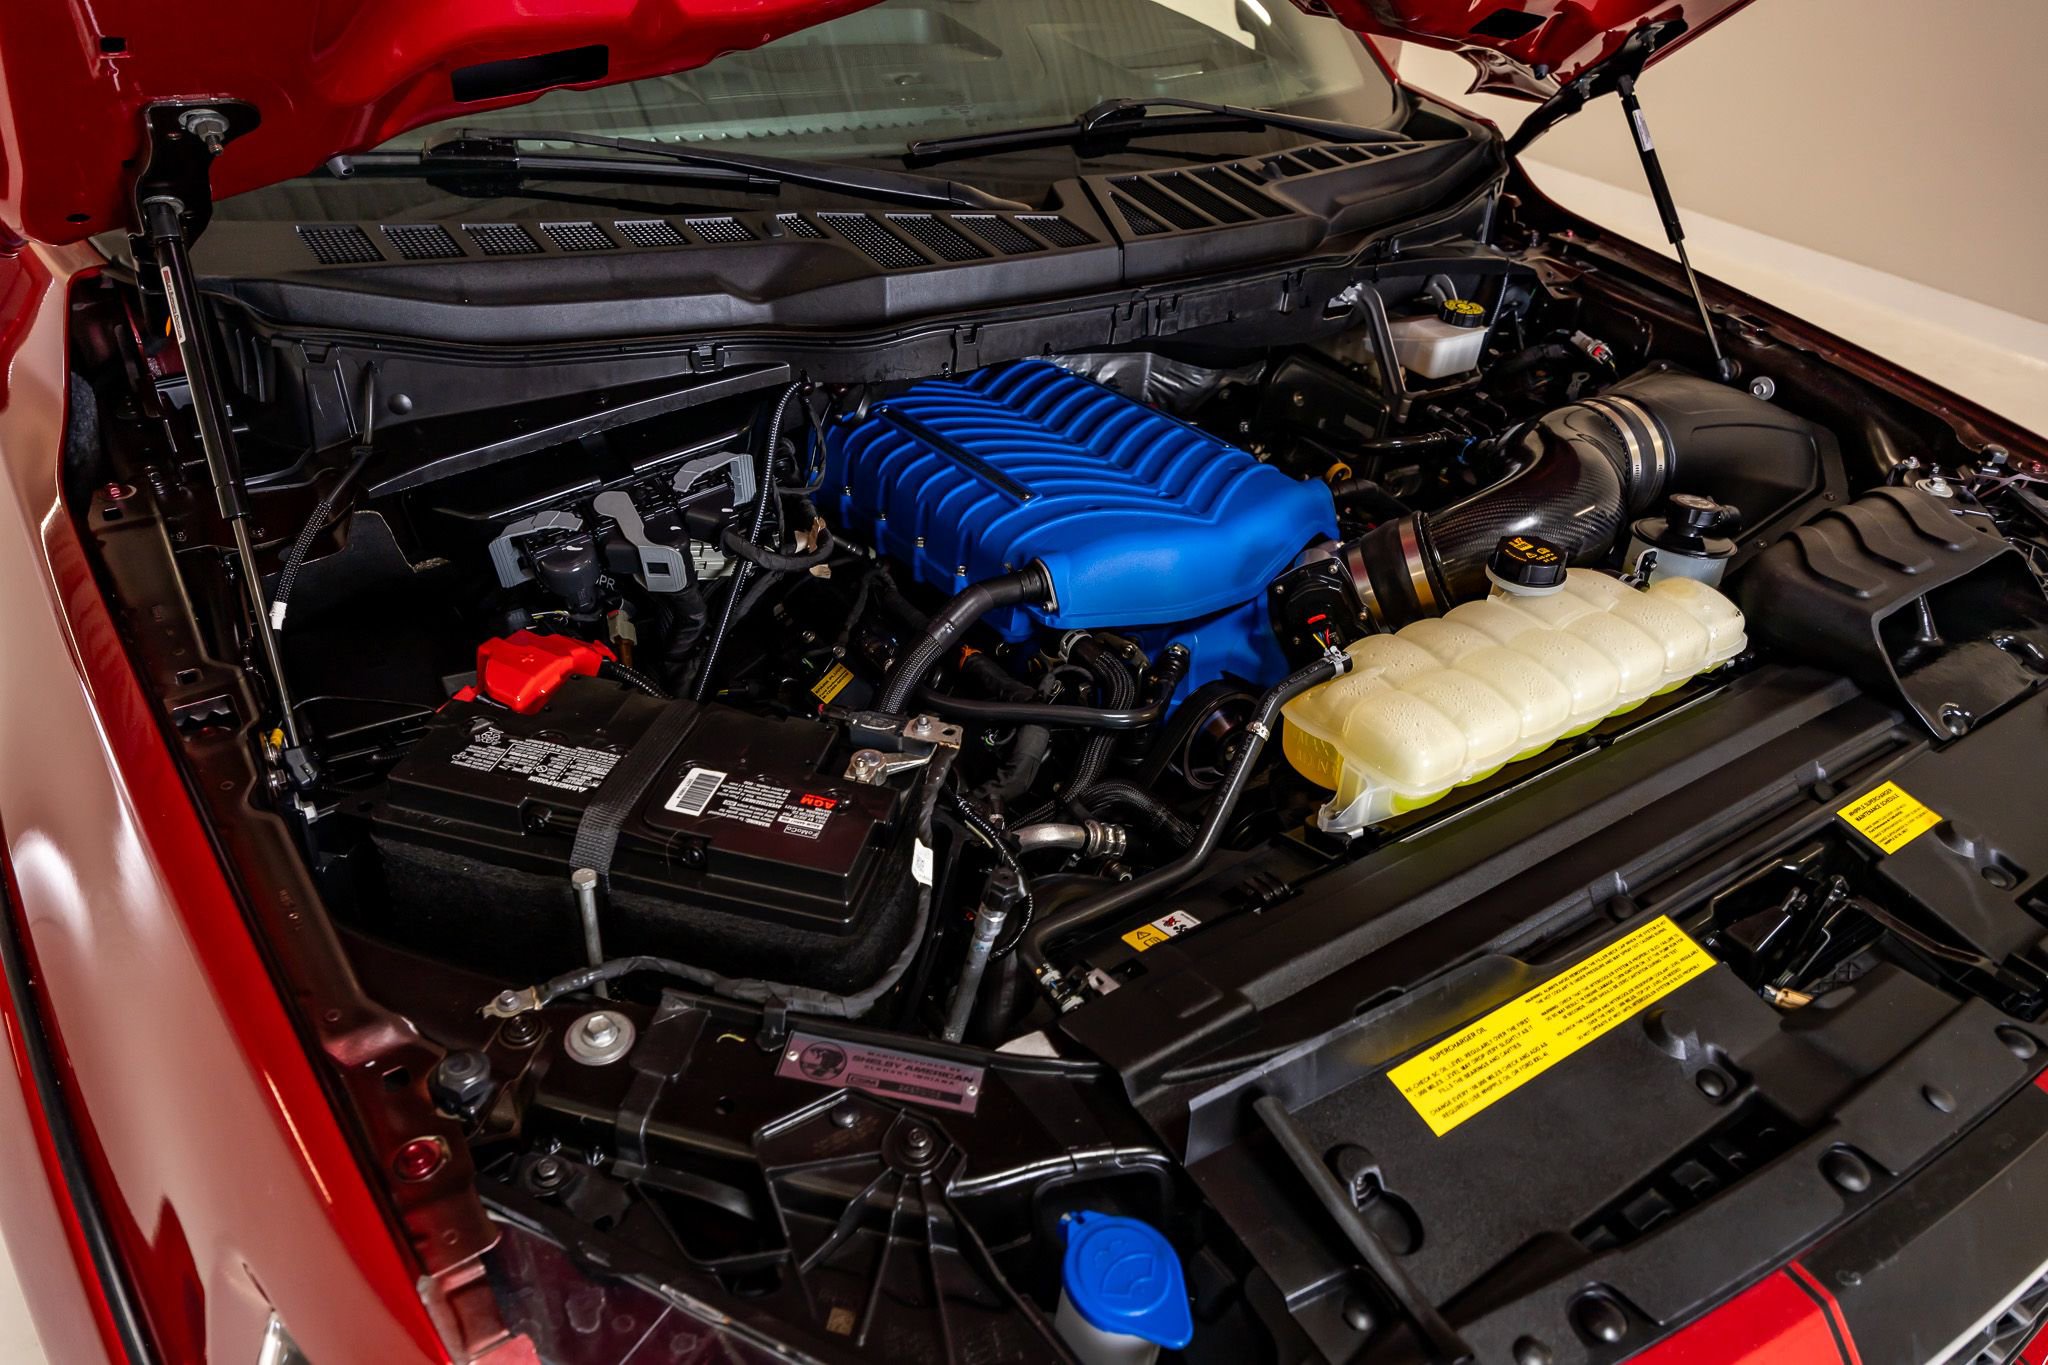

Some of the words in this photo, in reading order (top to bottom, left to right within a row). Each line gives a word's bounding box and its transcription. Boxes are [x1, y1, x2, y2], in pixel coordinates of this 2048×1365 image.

[595, 574, 615, 591] PR
[799, 796, 835, 809] AGM
[785, 826, 818, 837] FoMoCo
[1428, 1031, 1477, 1062] SUPERCHARGER
[1475, 1025, 1487, 1034] OIL
[851, 1054, 901, 1070] SHELBY
[904, 1064, 974, 1084] AMERICAN
